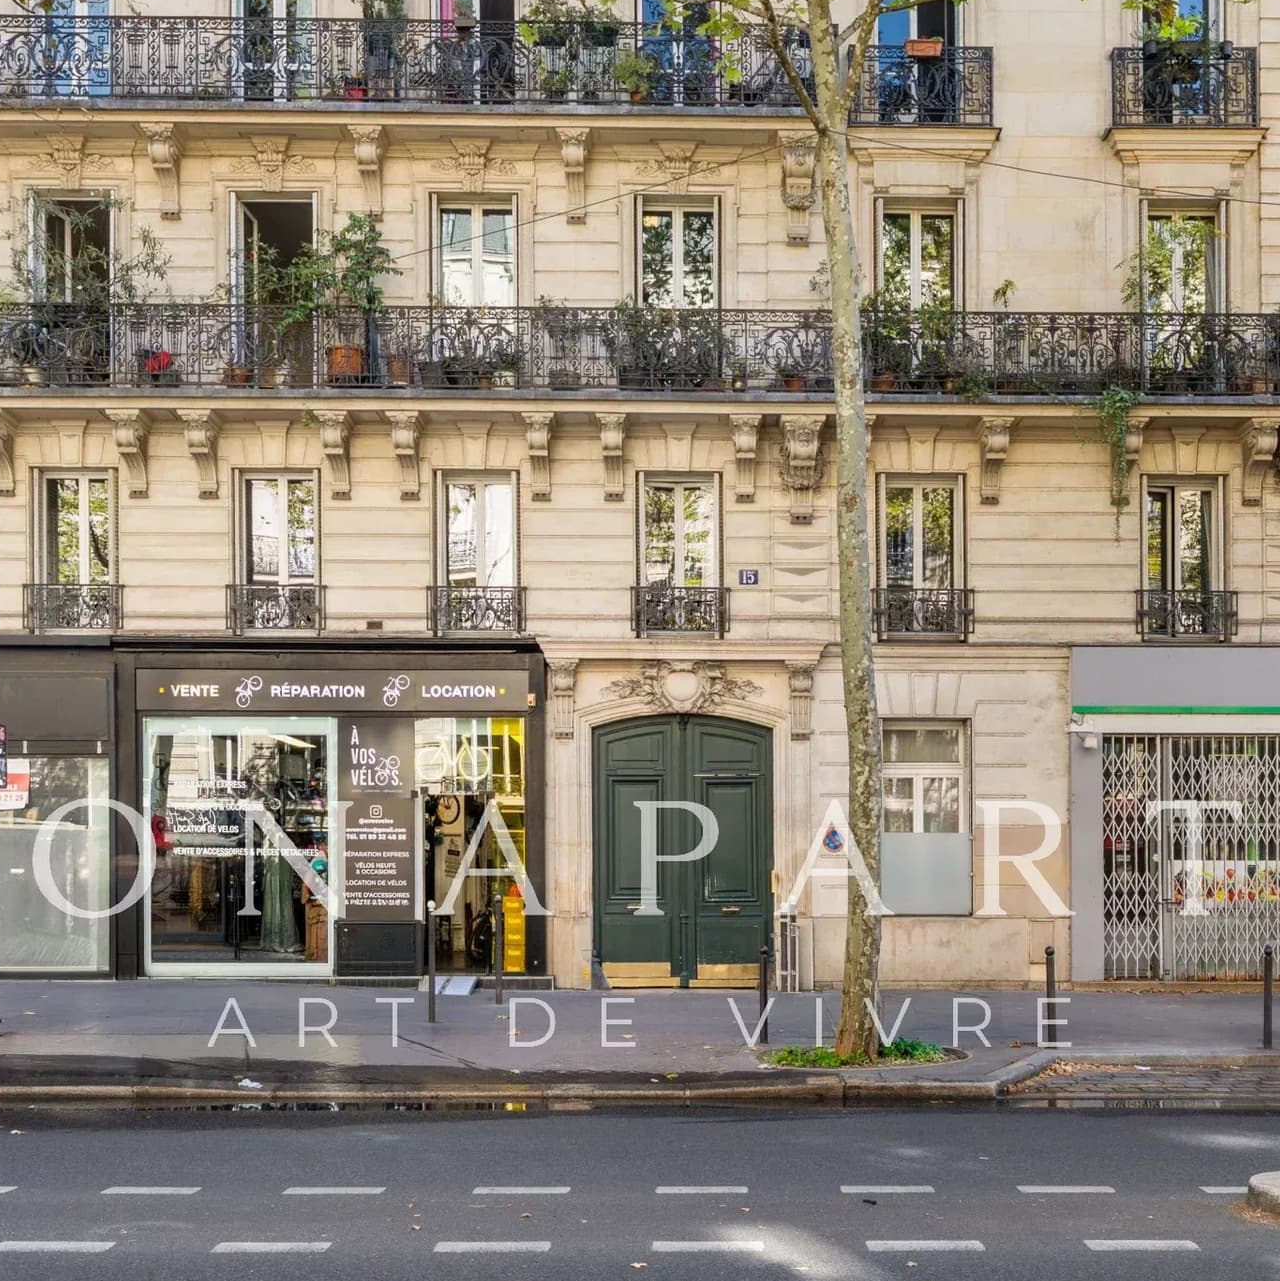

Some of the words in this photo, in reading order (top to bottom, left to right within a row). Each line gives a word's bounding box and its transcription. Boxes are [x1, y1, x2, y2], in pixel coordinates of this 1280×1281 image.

[742, 570, 755, 584] 15
[170, 684, 220, 698] VENTE
[271, 682, 366, 698] RÉPARATION
[421, 684, 497, 698] LOCATION
[350, 725, 360, 745] À
[350, 748, 377, 765] VOS
[173, 825, 206, 833] LOCATION
[208, 825, 216, 833] DE
